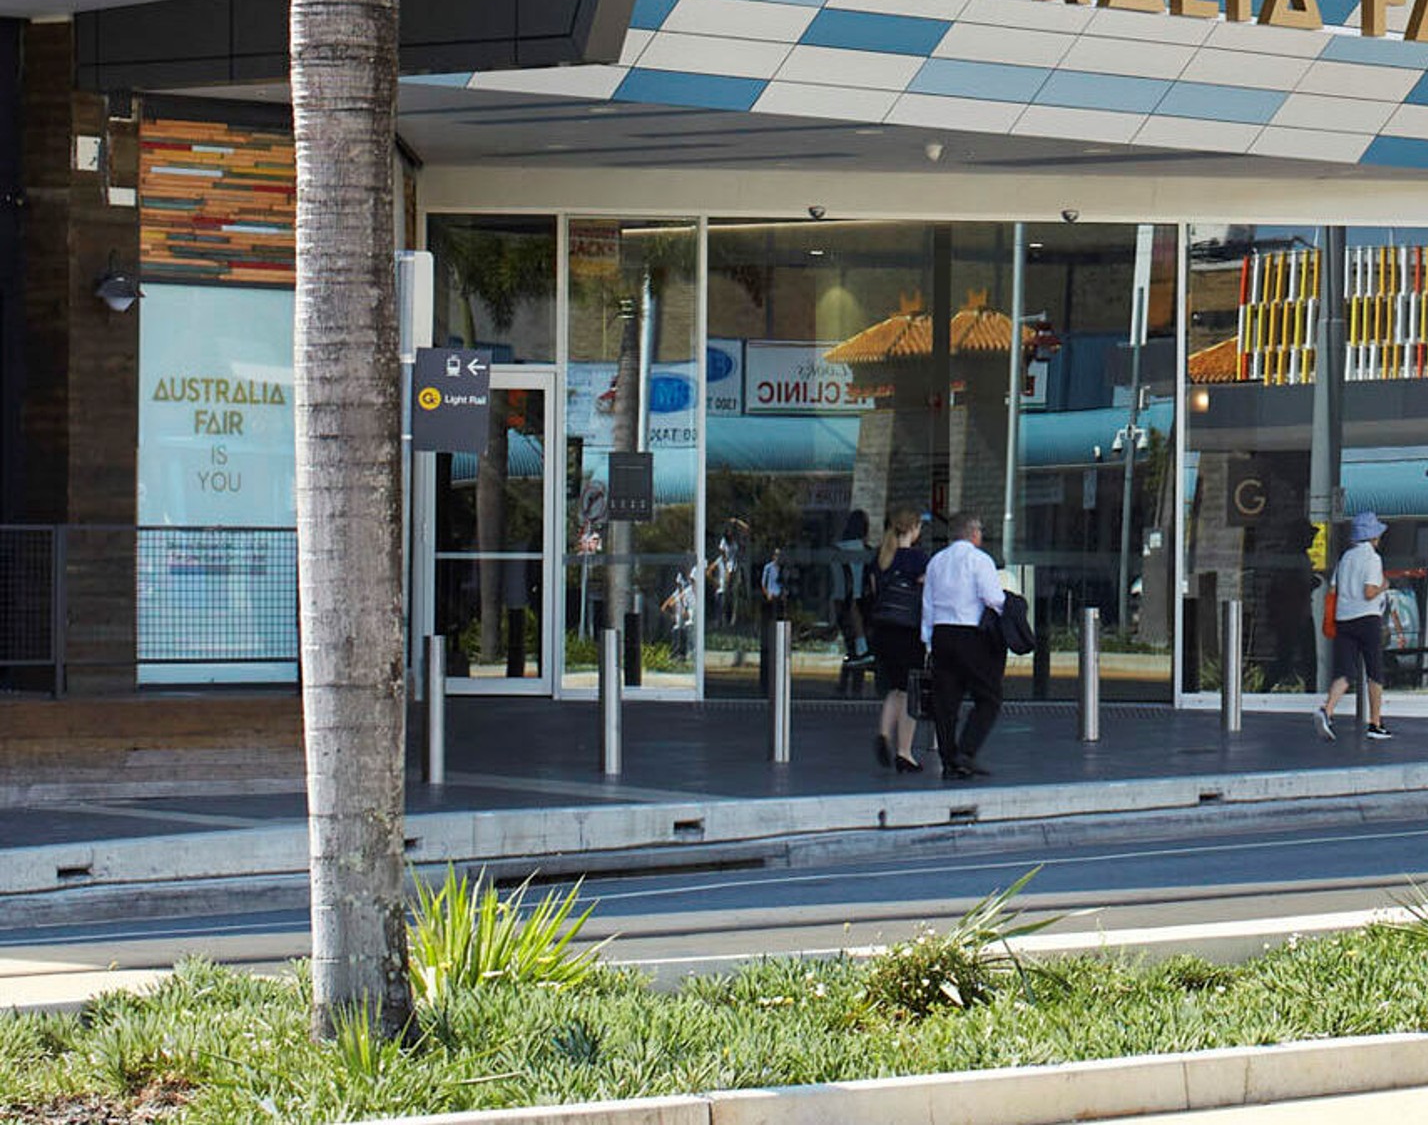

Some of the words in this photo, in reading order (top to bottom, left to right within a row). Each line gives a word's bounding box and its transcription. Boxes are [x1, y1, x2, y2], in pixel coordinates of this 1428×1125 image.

[152, 378, 286, 405] AUSTRALIA
[444, 395, 467, 406] Light
[469, 396, 487, 405] Rail
[194, 410, 244, 435] FAIR
[211, 445, 228, 465] IS
[197, 472, 241, 492] YOU
[1234, 478, 1267, 515] G
